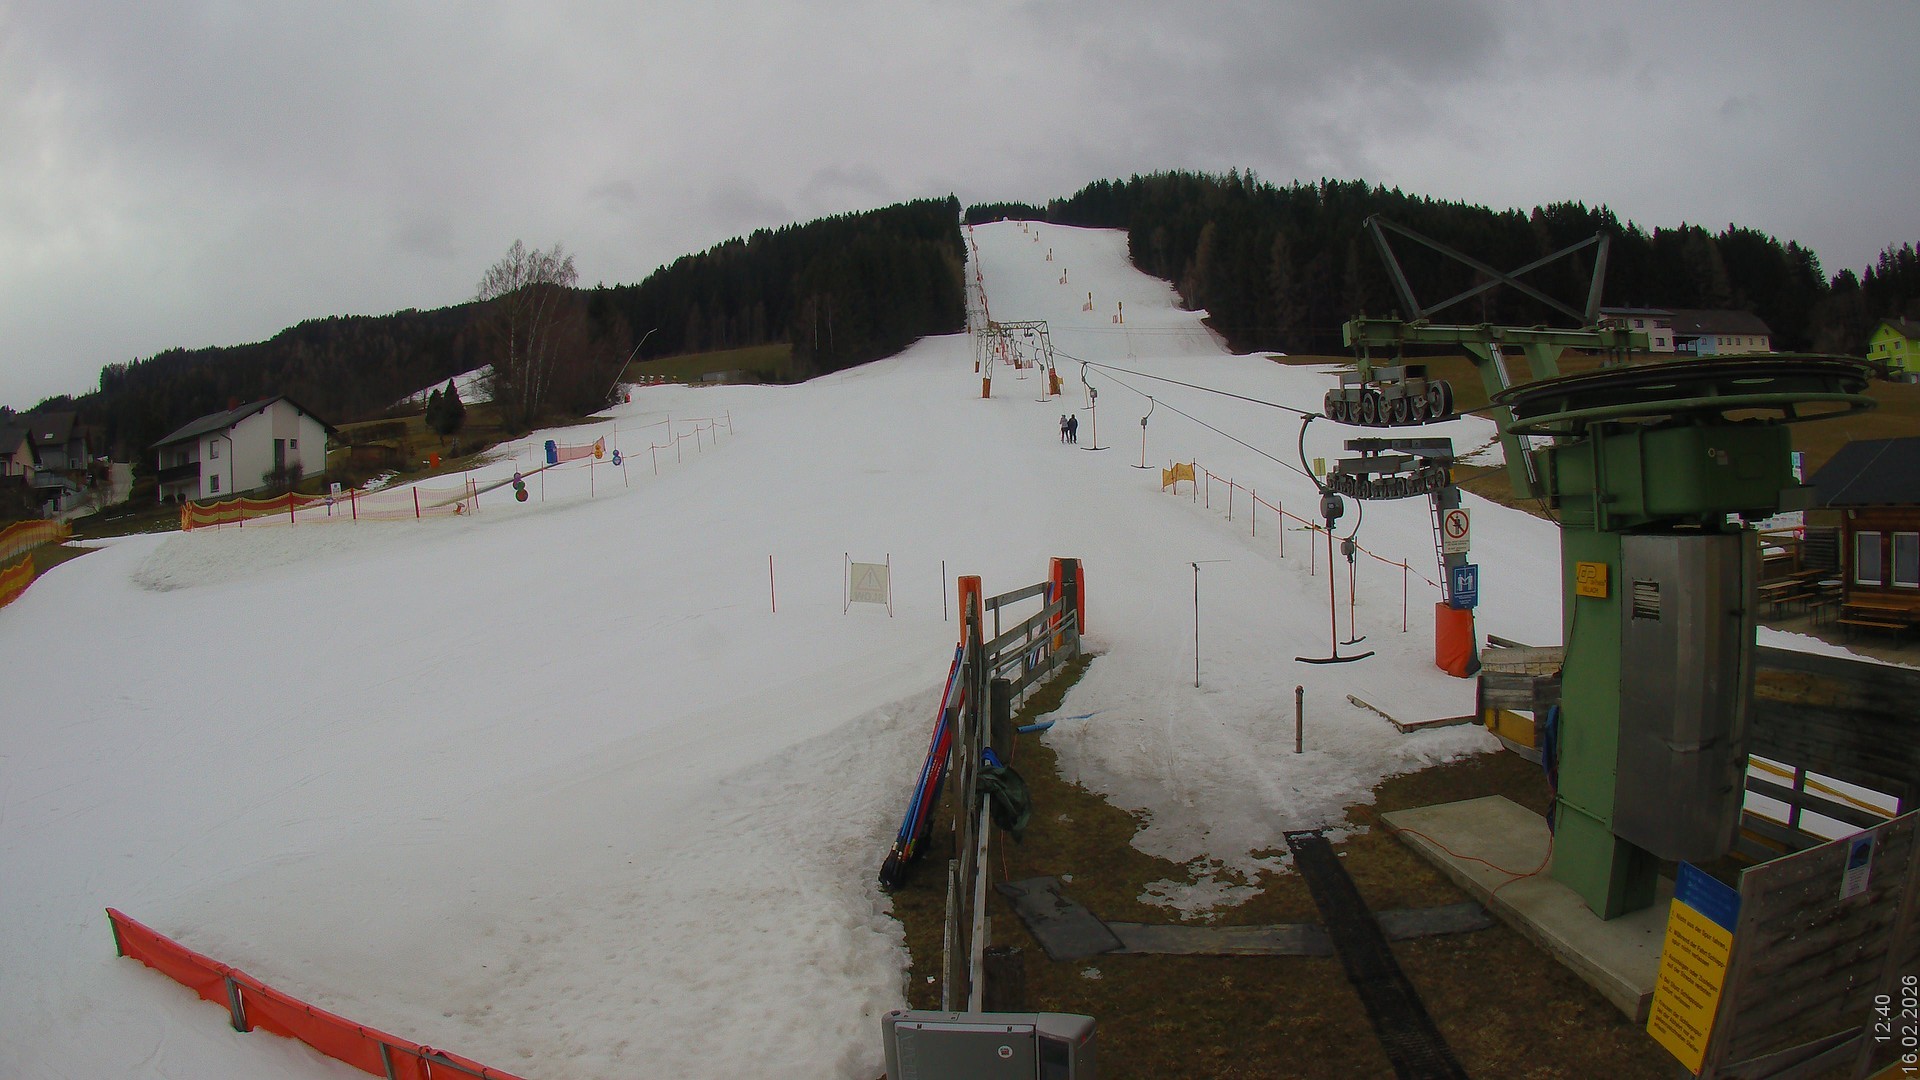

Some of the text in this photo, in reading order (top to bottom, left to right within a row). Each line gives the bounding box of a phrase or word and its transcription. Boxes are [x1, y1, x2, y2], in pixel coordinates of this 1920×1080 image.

[1676, 913, 1686, 922] Nicht
[1702, 931, 1711, 940] Spur
[1674, 930, 1689, 942] Während
[1697, 946, 1707, 955] Fahrt
[1681, 944, 1690, 952] nicht
